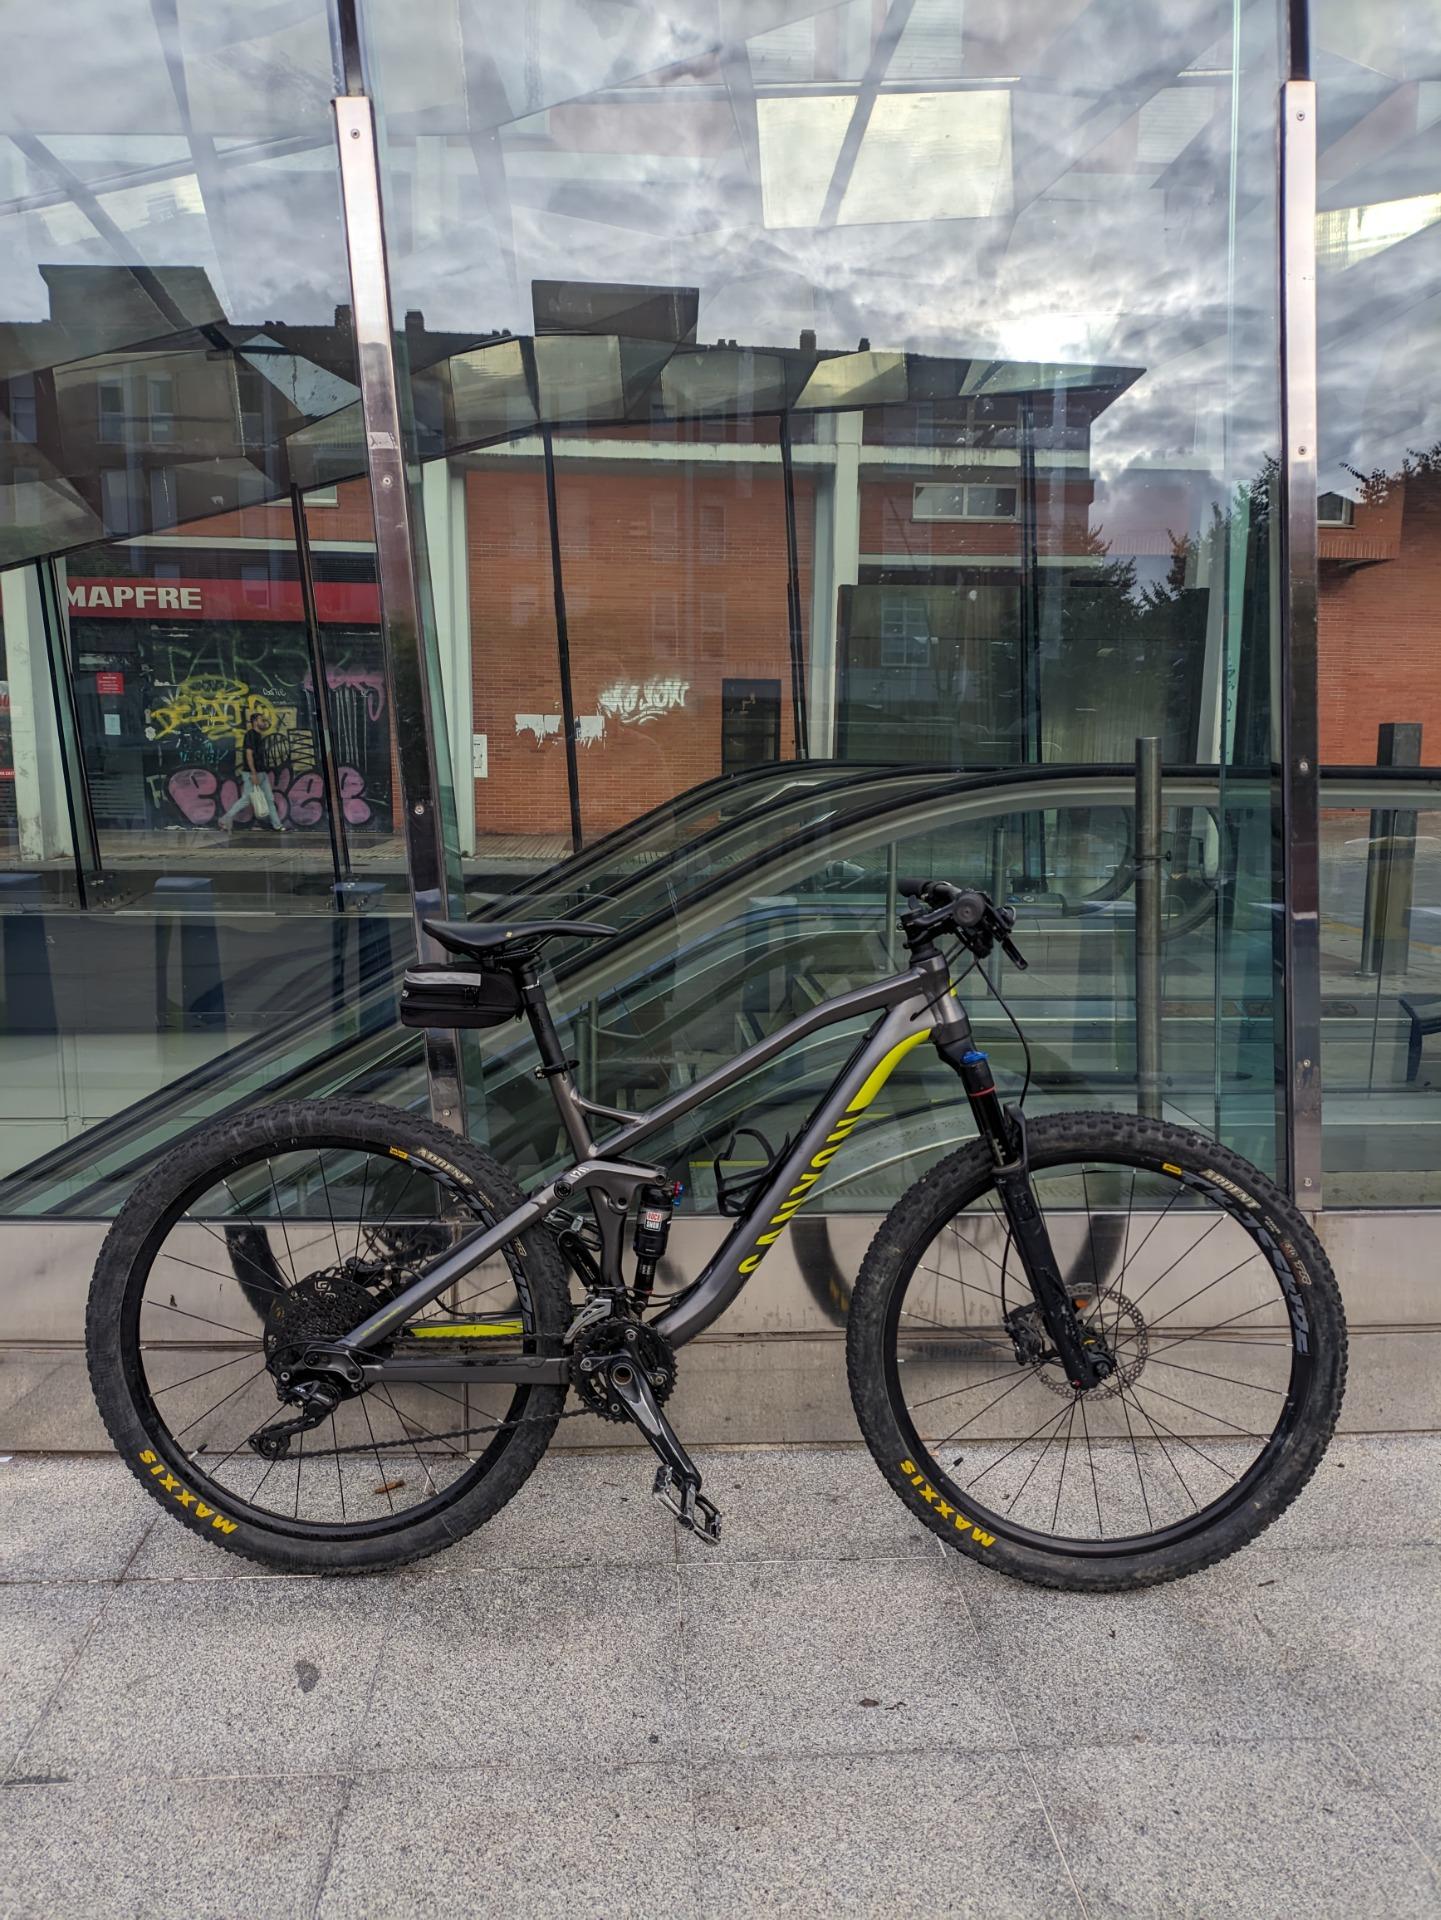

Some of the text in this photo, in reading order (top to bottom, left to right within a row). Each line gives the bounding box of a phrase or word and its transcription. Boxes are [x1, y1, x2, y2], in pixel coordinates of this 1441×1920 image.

[66, 585, 202, 610] MAPFRE
[139, 1449, 239, 1534] MAXXIS
[900, 1460, 996, 1547] MAXXIS
